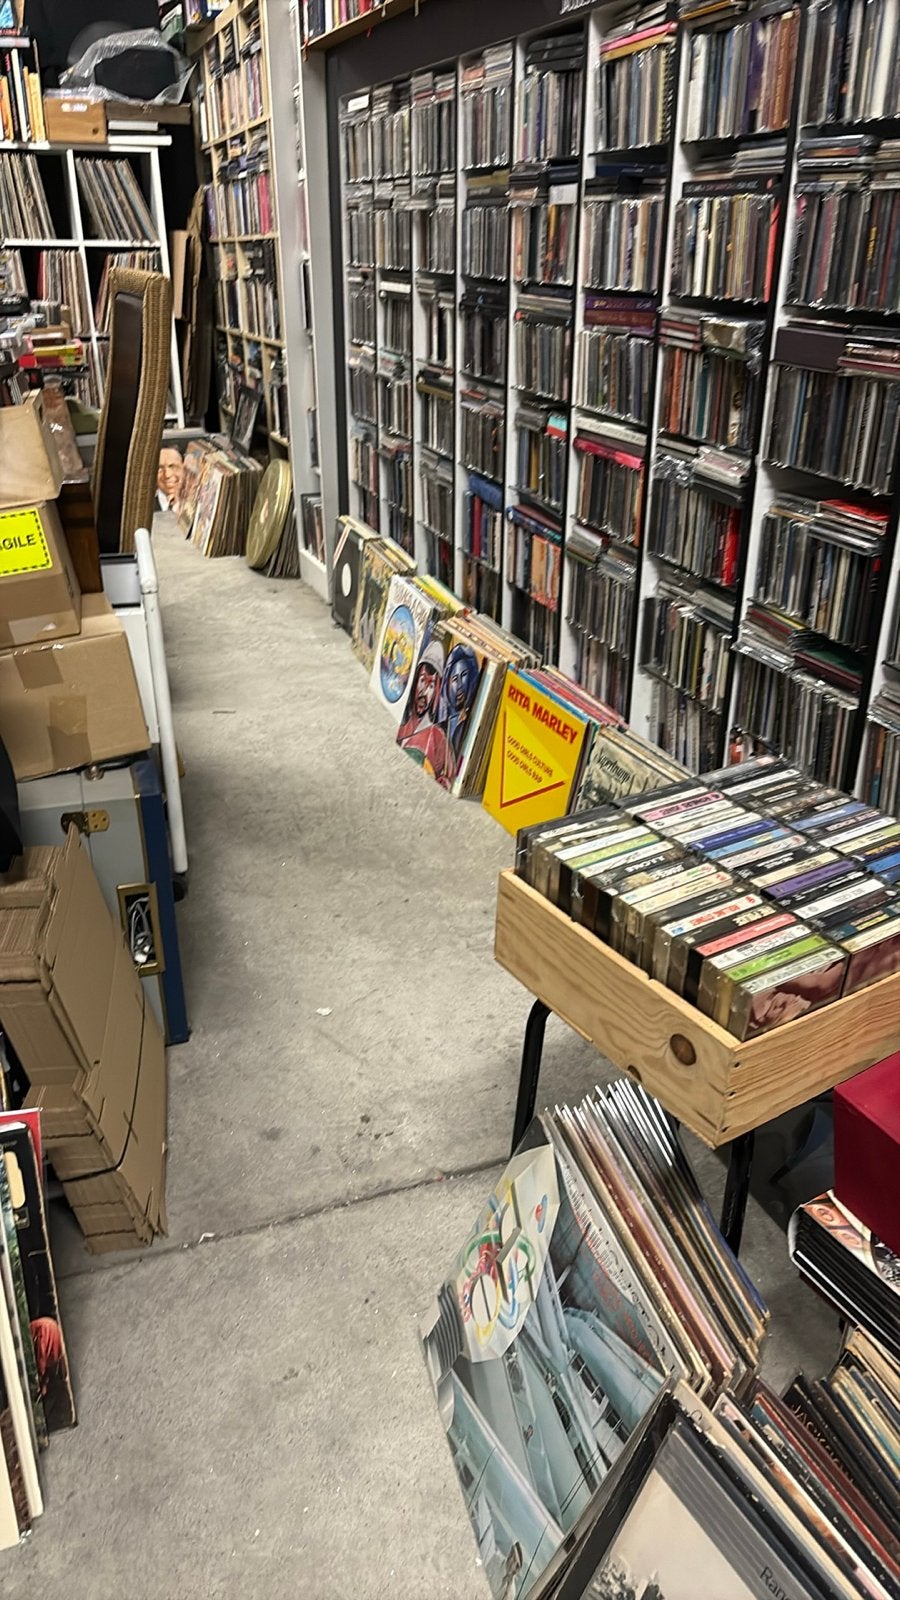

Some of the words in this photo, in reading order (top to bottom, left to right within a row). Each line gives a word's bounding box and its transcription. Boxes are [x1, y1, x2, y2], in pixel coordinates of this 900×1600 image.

[508, 685, 530, 712] RITA
[532, 702, 578, 744] MARLEY
[760, 1566, 790, 1600] Ran
